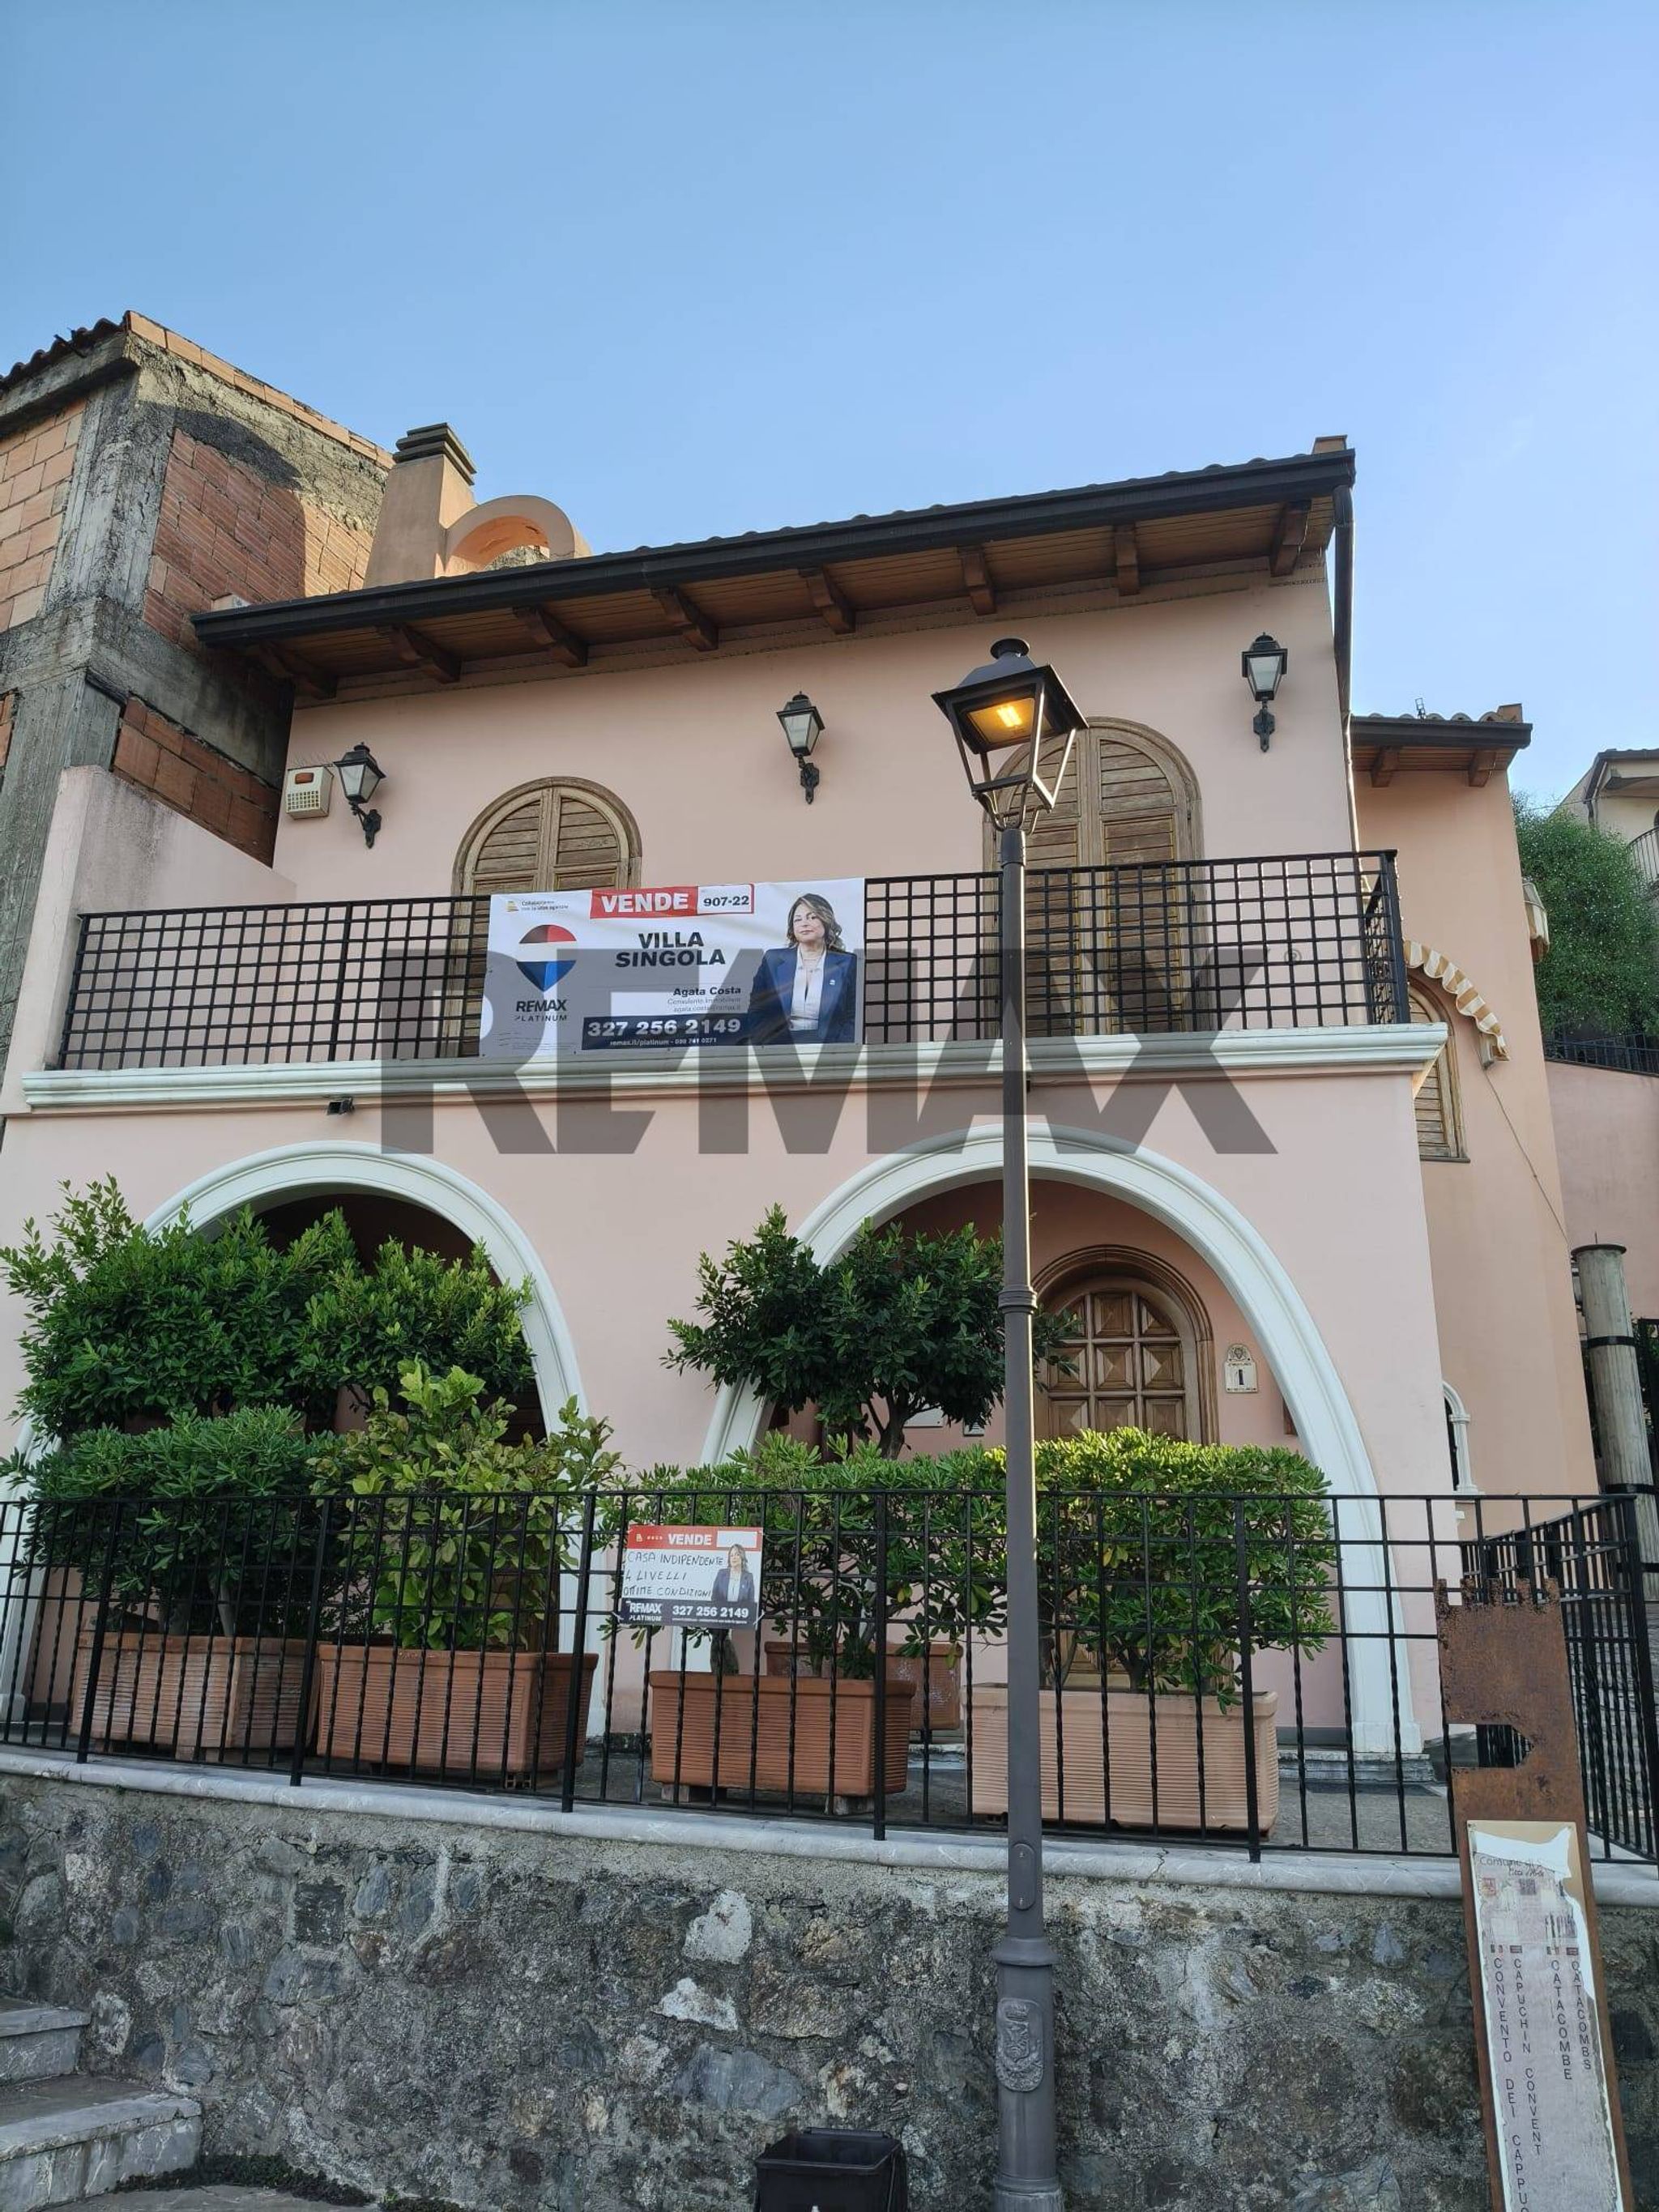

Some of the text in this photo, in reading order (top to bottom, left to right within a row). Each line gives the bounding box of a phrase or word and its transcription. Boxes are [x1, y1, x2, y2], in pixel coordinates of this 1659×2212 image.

[601, 893, 749, 913] VENDE 907-22
[638, 931, 704, 949] VILLA
[615, 948, 726, 968] SINGOLA
[673, 987, 741, 997] Agata Costa
[516, 999, 567, 1012] REMAX
[587, 1018, 741, 1037] 327 256 2149
[667, 1533, 713, 1545] VENDE
[628, 1552, 723, 1566] CASA INDIPENDENTE
[637, 1571, 687, 1580] LIVELLI
[657, 1587, 712, 1597] CONDIZIONI
[629, 1602, 662, 1613] REMAX
[672, 1606, 749, 1618] 327 256 2149
[1551, 1959, 1572, 2080] CATACOMBE
[1572, 1961, 1592, 2069] CATACOMBS
[1494, 1958, 1512, 2062] CONVENTO
[1506, 2078, 1516, 2117] DEI
[1514, 1958, 1541, 2155] CAPUCHIN CONVENT
